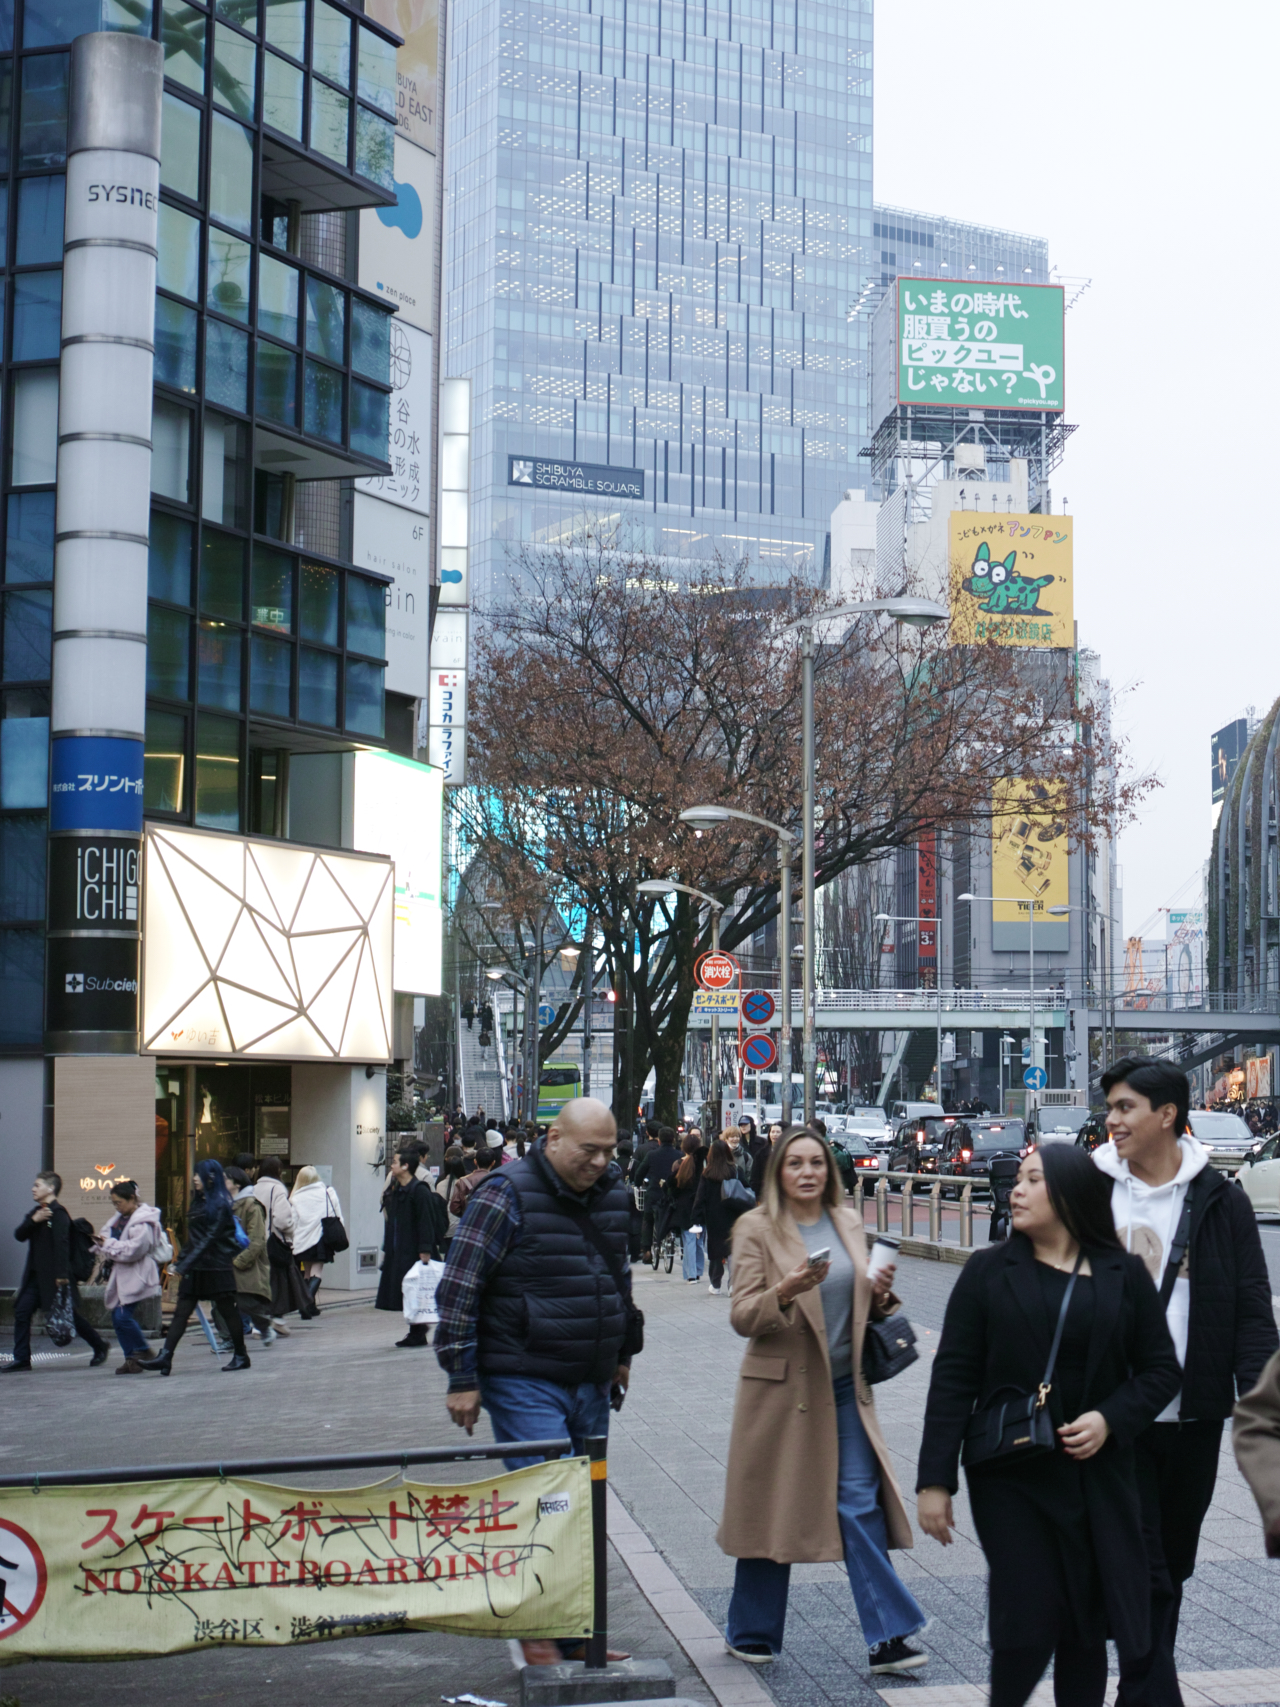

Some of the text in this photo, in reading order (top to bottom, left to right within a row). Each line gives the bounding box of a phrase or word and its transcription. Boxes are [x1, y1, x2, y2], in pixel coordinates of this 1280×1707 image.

[409, 97, 433, 125] EAST
[386, 284, 417, 307] zen place
[904, 289, 1029, 319] いまの時代、
[903, 313, 998, 342] 服買うの
[907, 342, 1020, 366] ピックユー
[907, 366, 1017, 395] じゃない？
[1018, 397, 1059, 407] @pickyou.app
[388, 428, 421, 456] の水
[389, 454, 421, 485] 形成
[535, 462, 585, 477] SHIBUYA
[535, 474, 641, 495] SCRAMBLE SQUARE
[412, 525, 424, 541] 6F
[367, 550, 417, 576] hair salon
[385, 586, 415, 615] ain
[433, 635, 463, 643] vain
[441, 690, 453, 780] ココカラファイン
[704, 965, 731, 979] 消火栓
[695, 994, 737, 1005] センタースポーツ
[80, 1488, 519, 1551] スケートボード禁止
[80, 1549, 519, 1598] NO SKATEBOARDING
